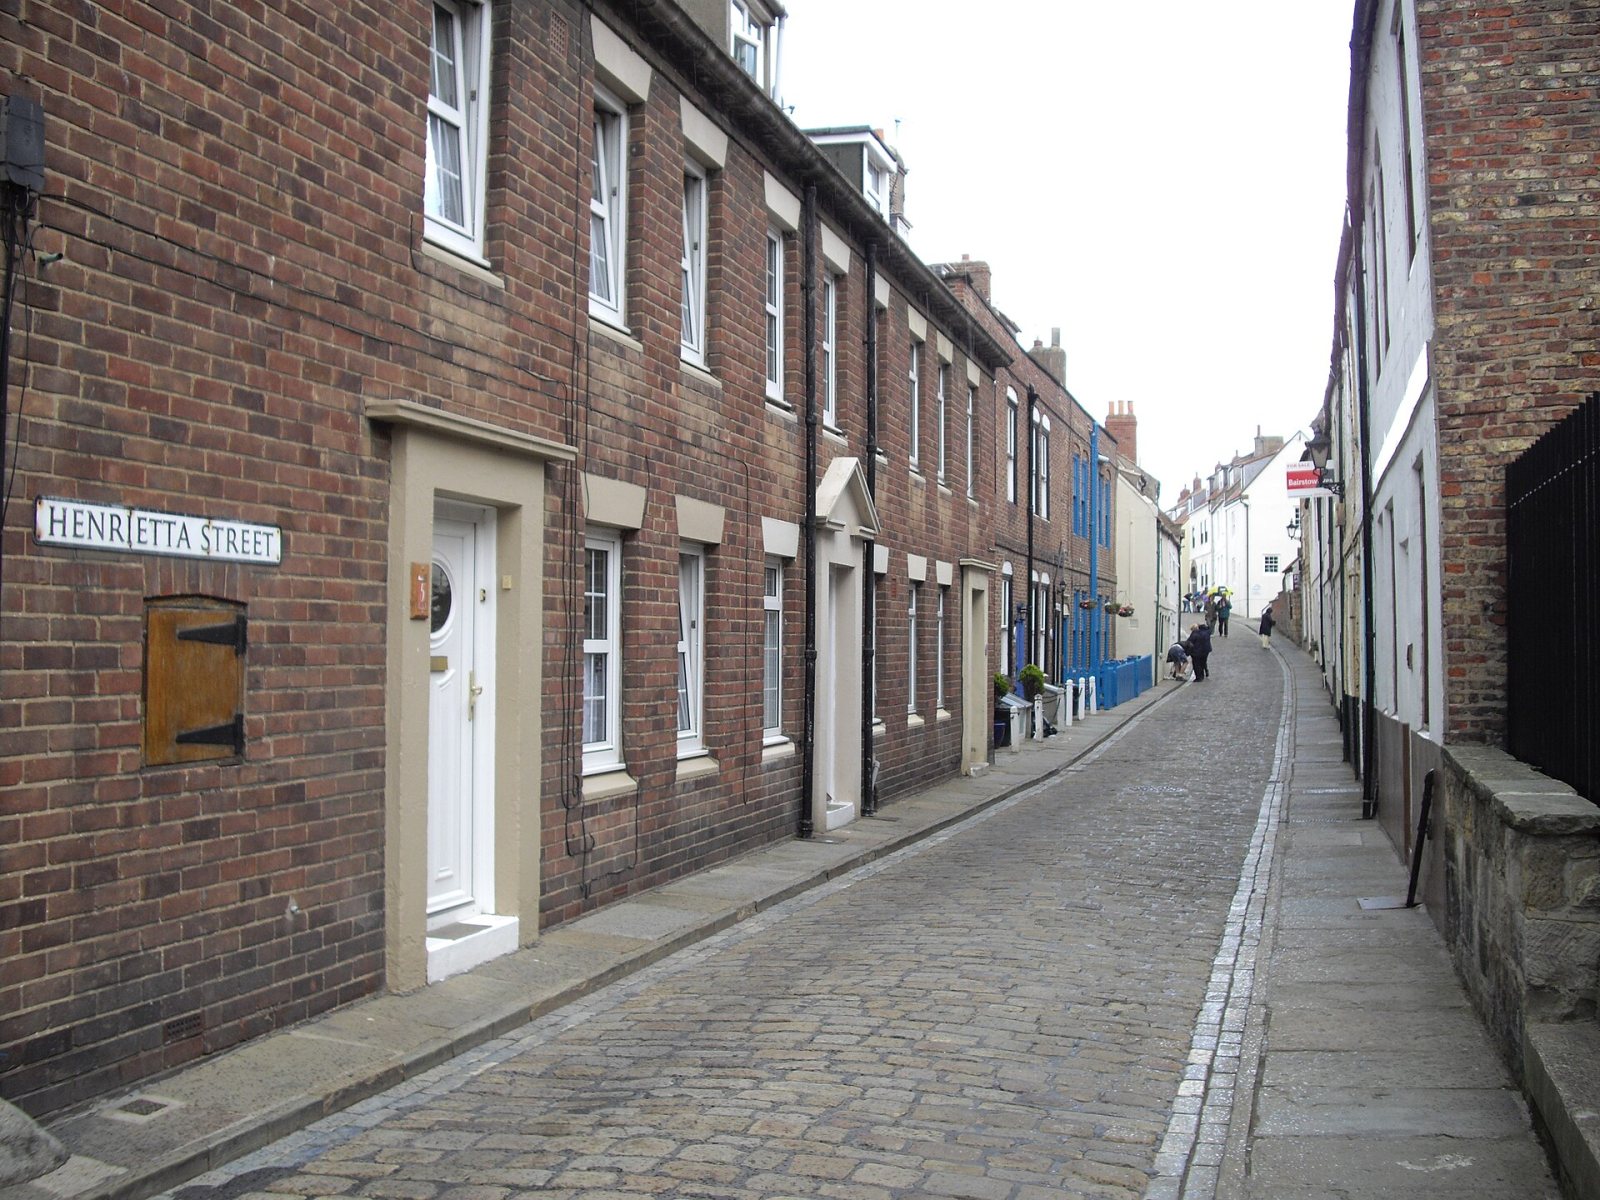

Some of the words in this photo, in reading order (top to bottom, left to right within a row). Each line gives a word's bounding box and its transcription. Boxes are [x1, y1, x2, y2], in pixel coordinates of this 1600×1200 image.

[1288, 478, 1318, 486] Bairstow
[48, 505, 192, 549] HENRIETTA
[200, 518, 274, 557] STREET
